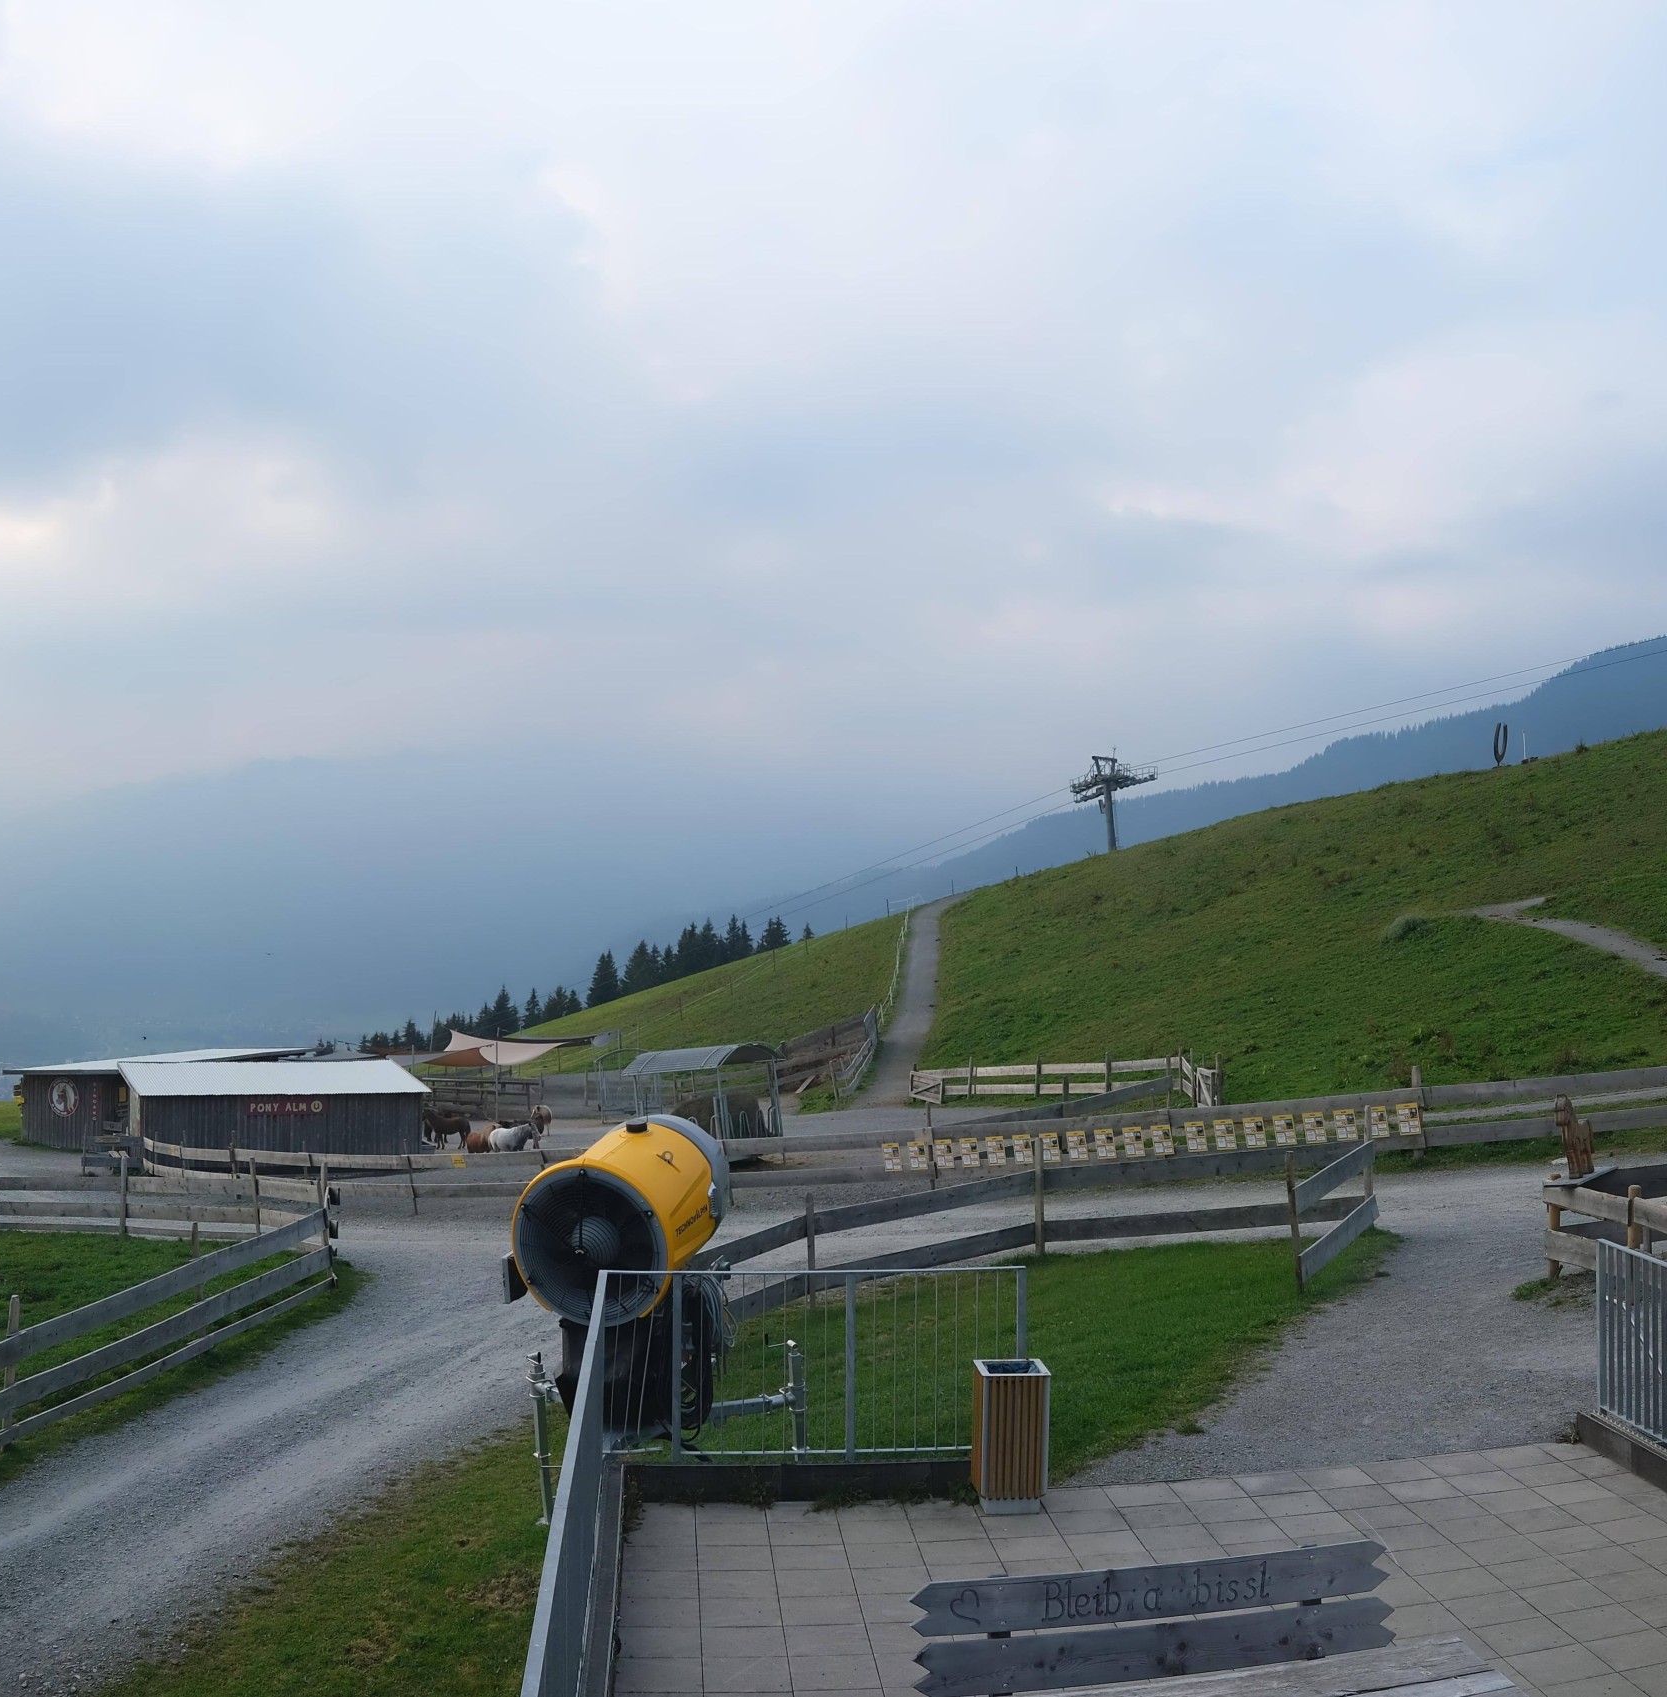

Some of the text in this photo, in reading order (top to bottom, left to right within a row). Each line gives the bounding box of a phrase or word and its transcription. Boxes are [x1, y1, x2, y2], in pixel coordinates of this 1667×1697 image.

[250, 1102, 307, 1113] PONY ALM
[1041, 1580, 1121, 1623] Bleib
[1192, 1560, 1270, 1607] bissl
